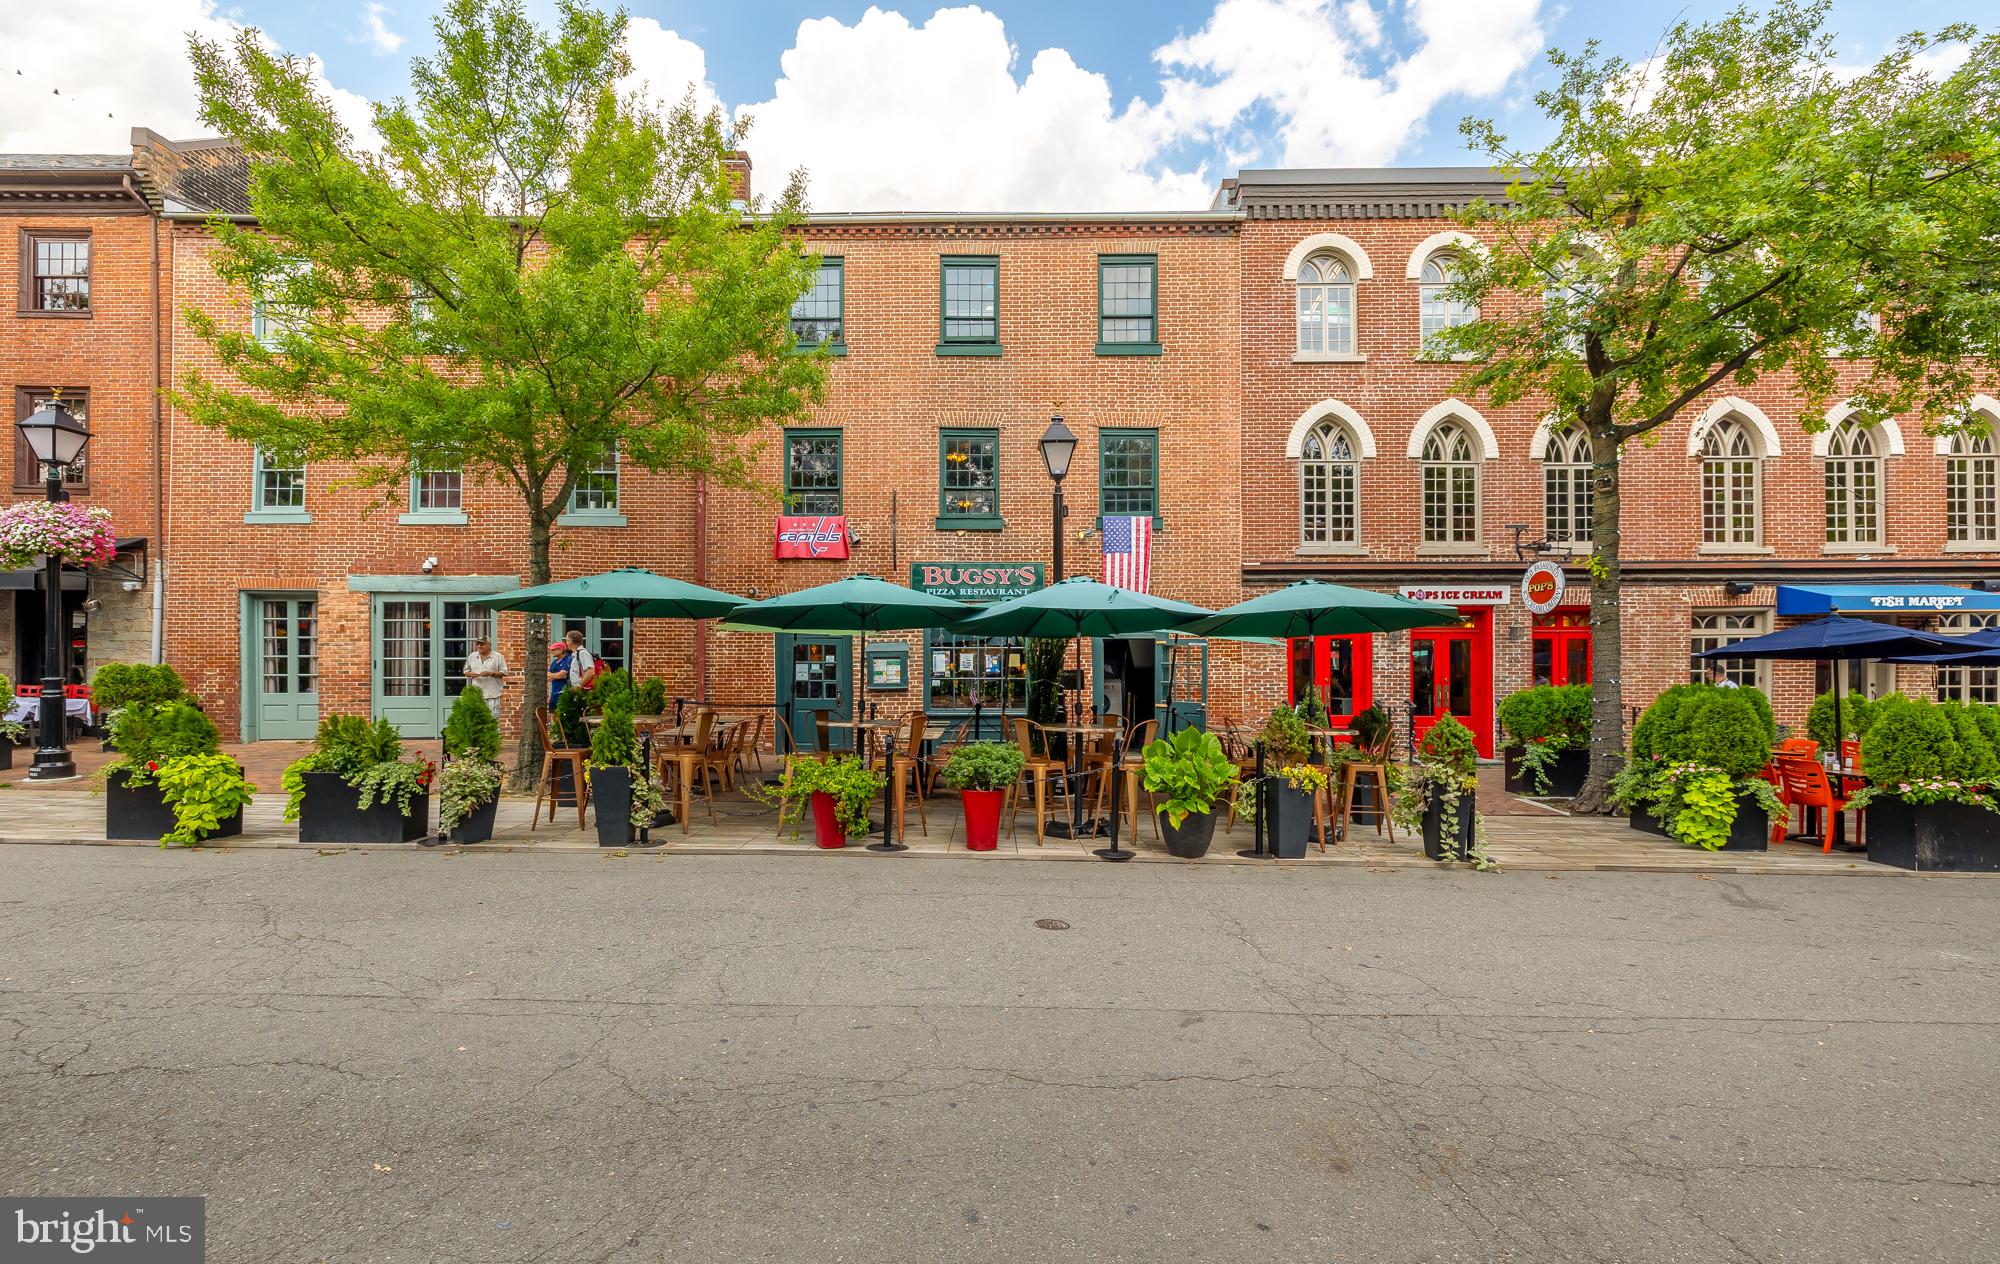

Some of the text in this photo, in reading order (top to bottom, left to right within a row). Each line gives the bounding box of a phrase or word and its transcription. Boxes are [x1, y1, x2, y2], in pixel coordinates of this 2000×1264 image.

[778, 516, 842, 557] capitals
[921, 566, 1035, 585] BUGSY'S
[926, 588, 1030, 596] PIZZA RESTAURANT
[1528, 581, 1554, 593] POPS
[1441, 590, 1460, 599] ICE
[1462, 590, 1503, 599] CREAM
[1870, 596, 1965, 610] FISH MARKET
